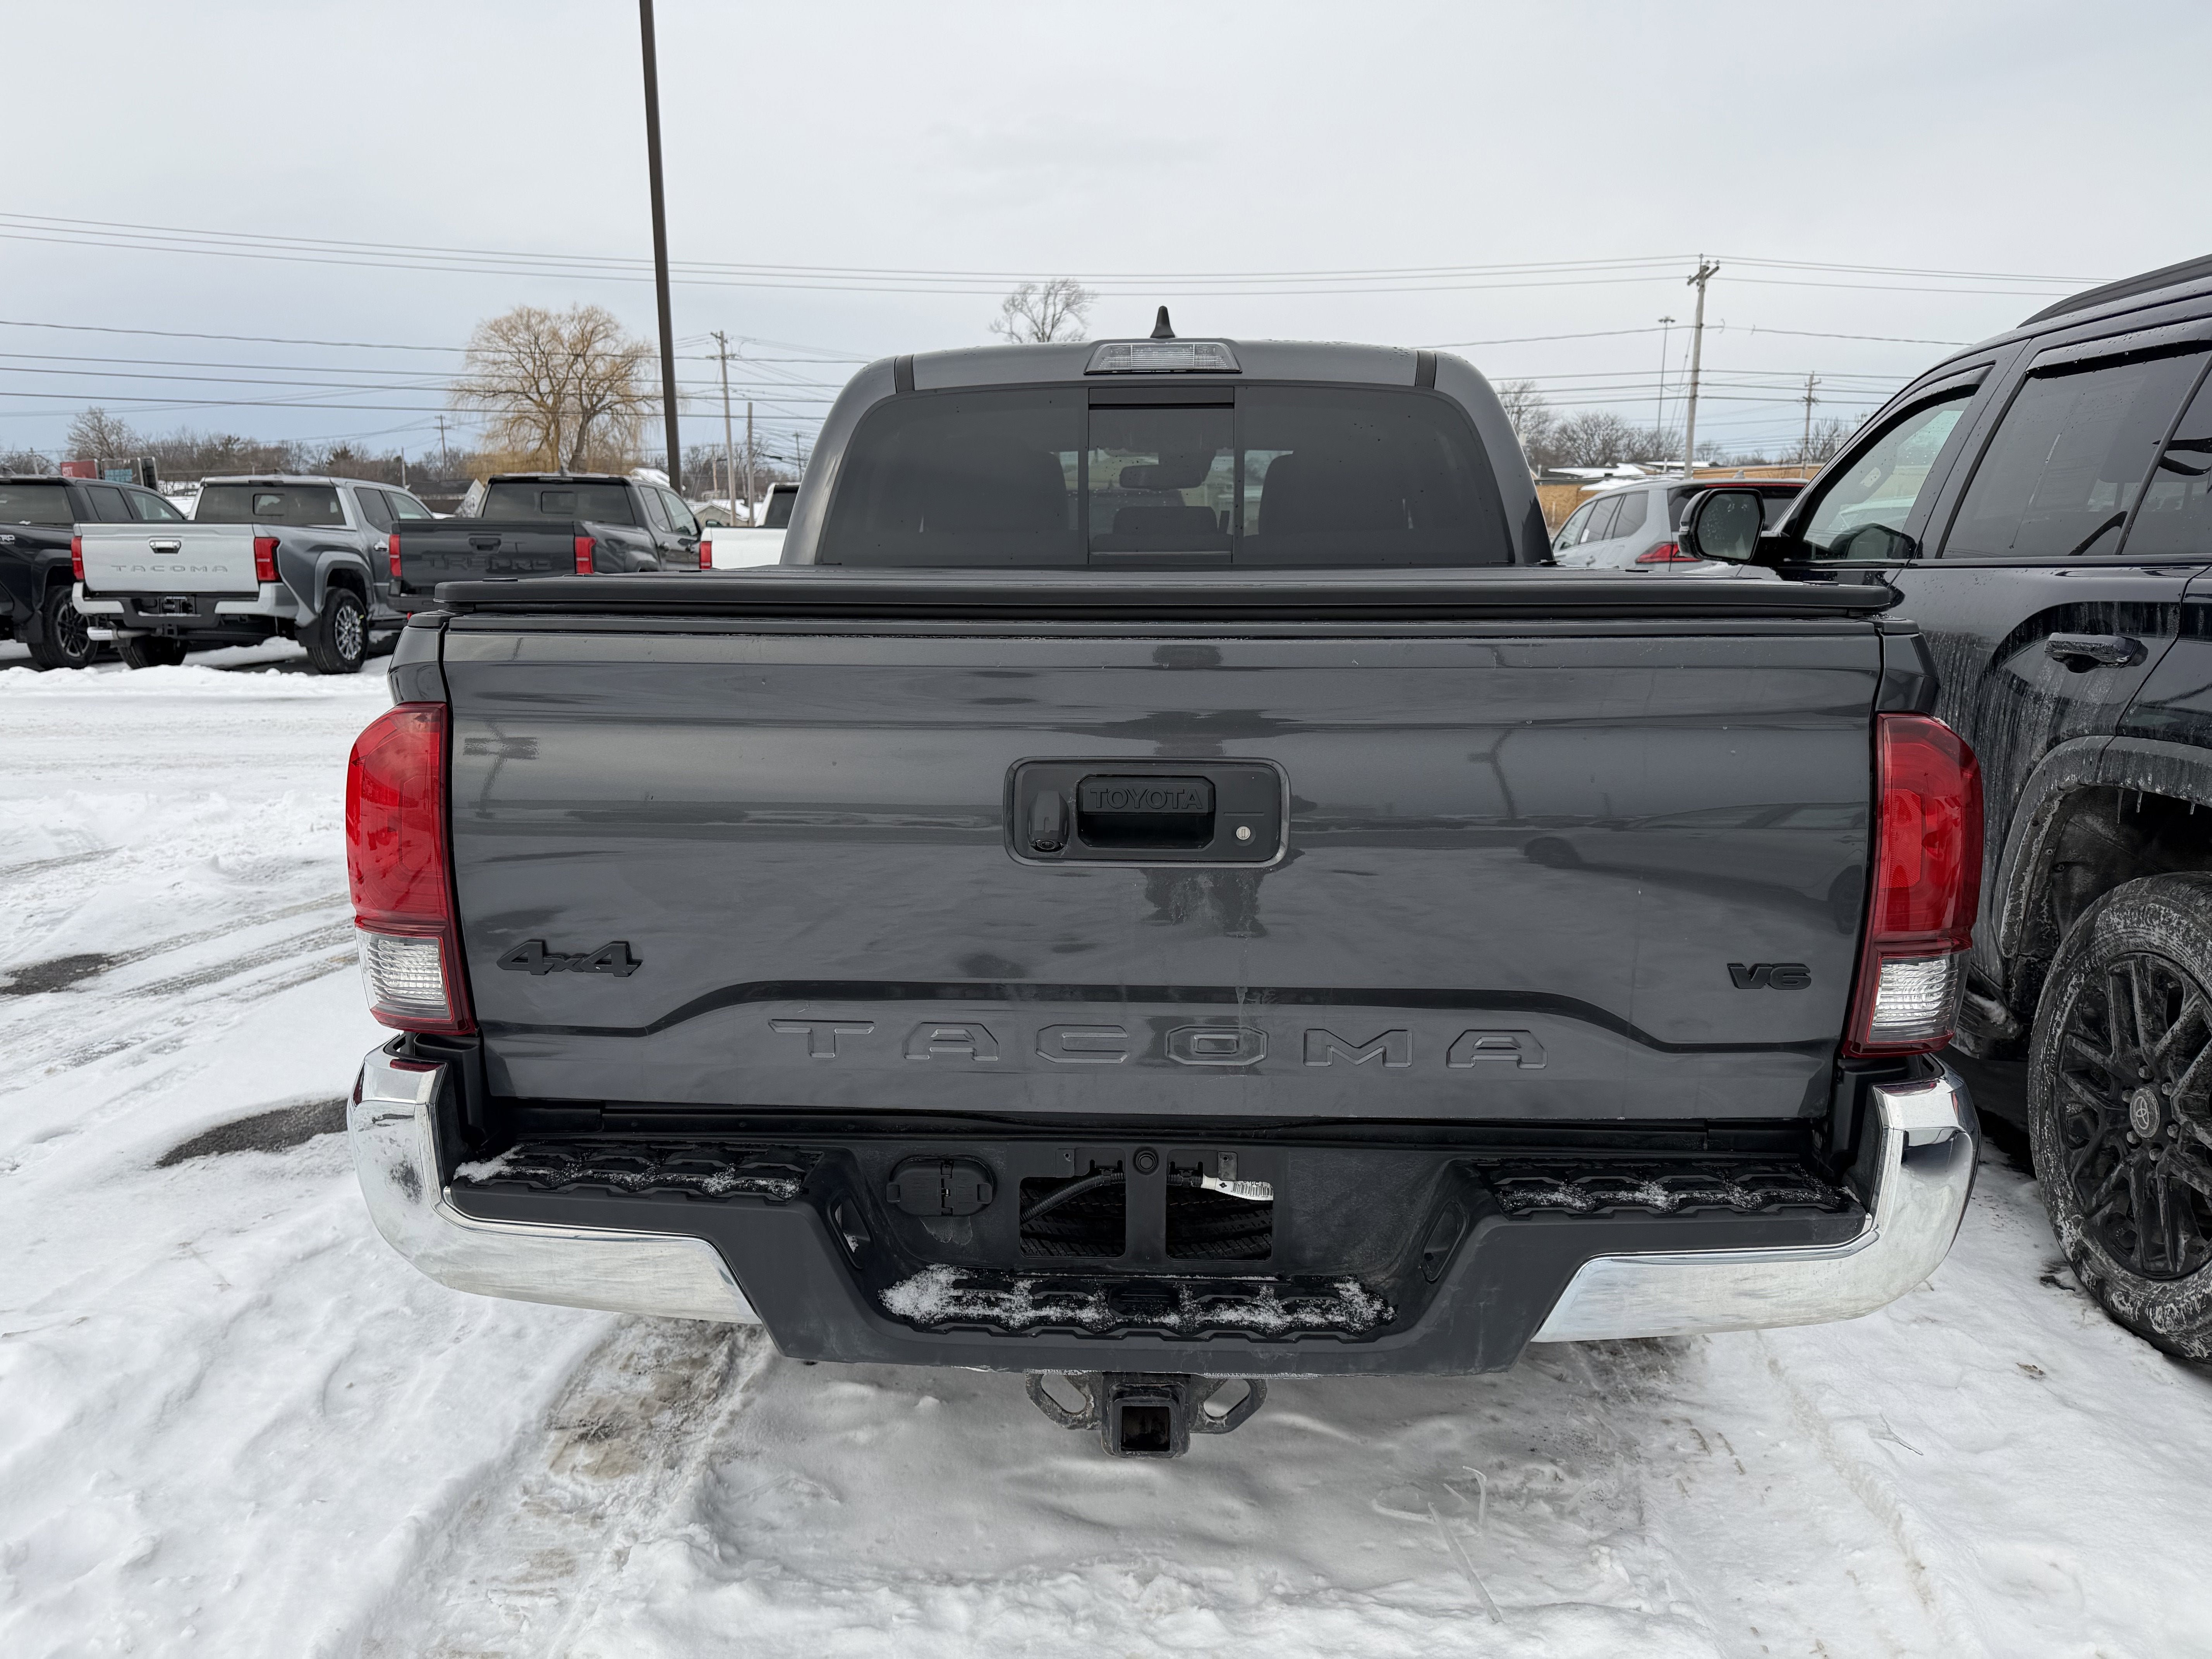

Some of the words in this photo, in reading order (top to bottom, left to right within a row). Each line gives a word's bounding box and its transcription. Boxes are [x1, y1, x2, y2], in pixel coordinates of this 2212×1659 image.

[490, 556, 552, 570] PRO
[1090, 788, 1203, 809] TOYOTA
[496, 939, 643, 977] 4x4
[1727, 963, 1812, 990] V6
[768, 1018, 1548, 1070] TACOMA
